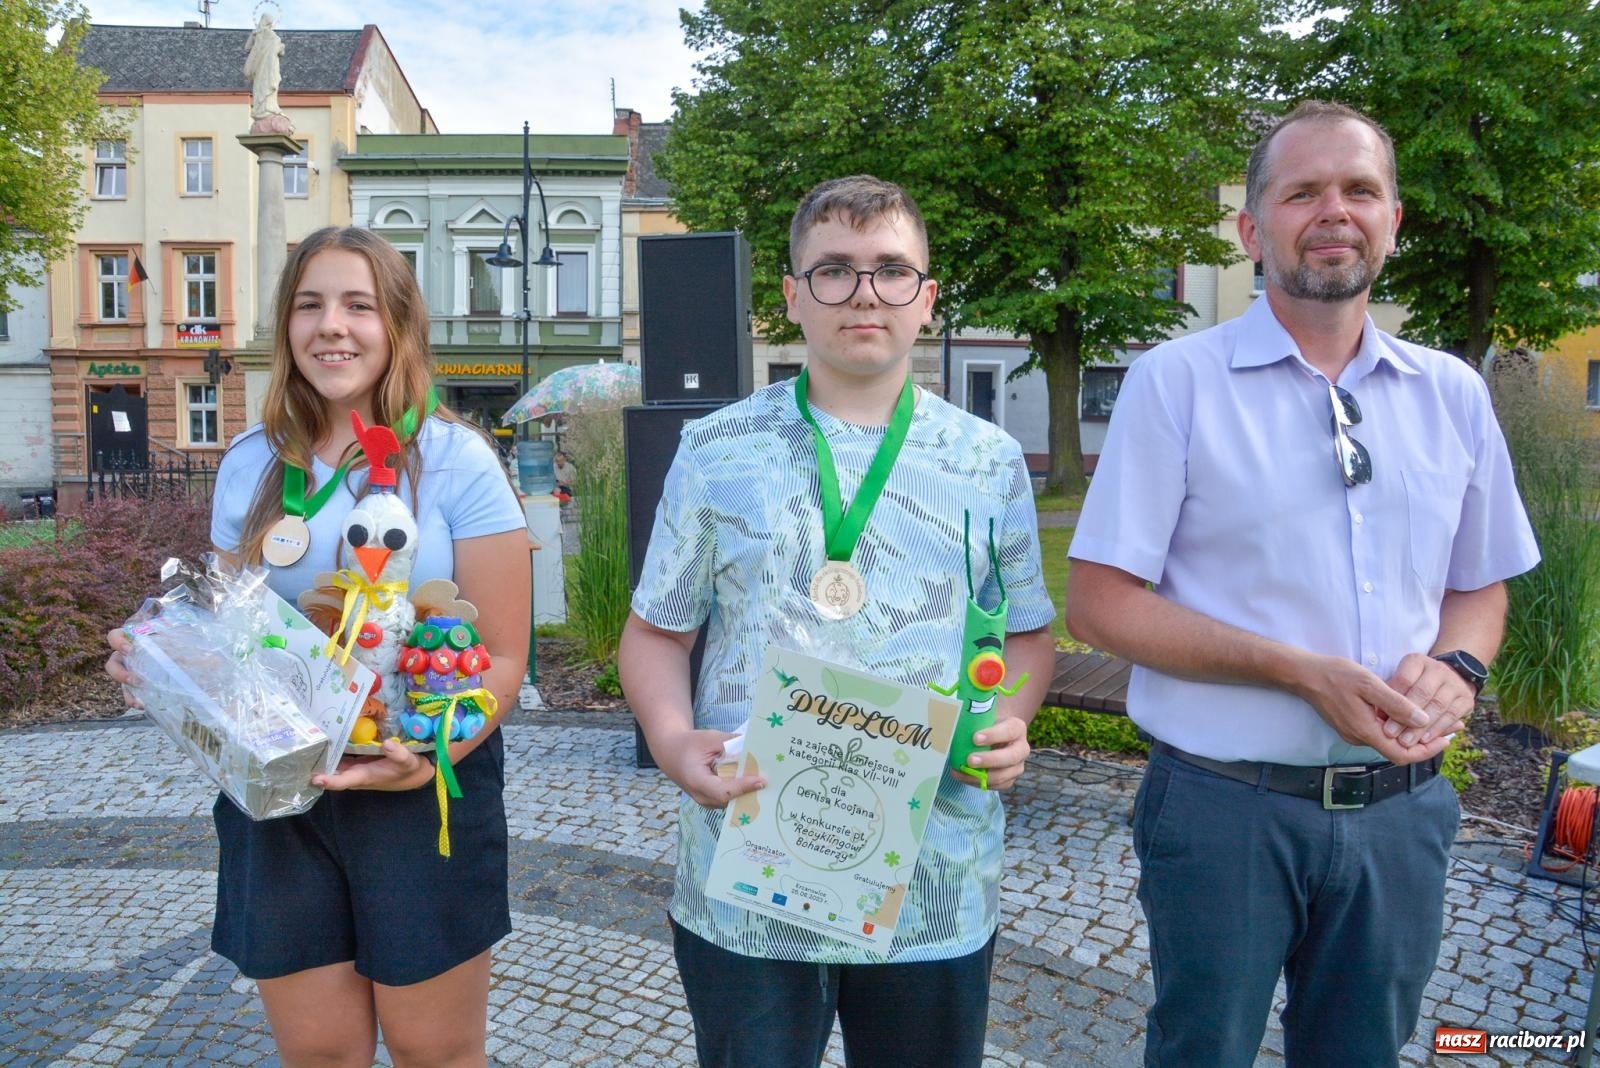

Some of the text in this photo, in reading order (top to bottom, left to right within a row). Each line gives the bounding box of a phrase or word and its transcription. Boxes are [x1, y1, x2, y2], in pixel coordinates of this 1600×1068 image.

[87, 361, 141, 378] Apteka
[685, 375, 697, 384] HK
[786, 688, 933, 750] DYPLOM
[788, 746, 899, 788] kategorii klas VII-VIII
[790, 736, 803, 746] za
[855, 756, 895, 774] miejsca
[898, 770, 906, 778] w
[796, 786, 831, 805] Denisa
[830, 785, 846, 797] dla
[790, 811, 798, 819] w
[801, 812, 851, 836] konkursie
[745, 840, 786, 857] Organizator
[854, 873, 896, 894] Gratulujemy
